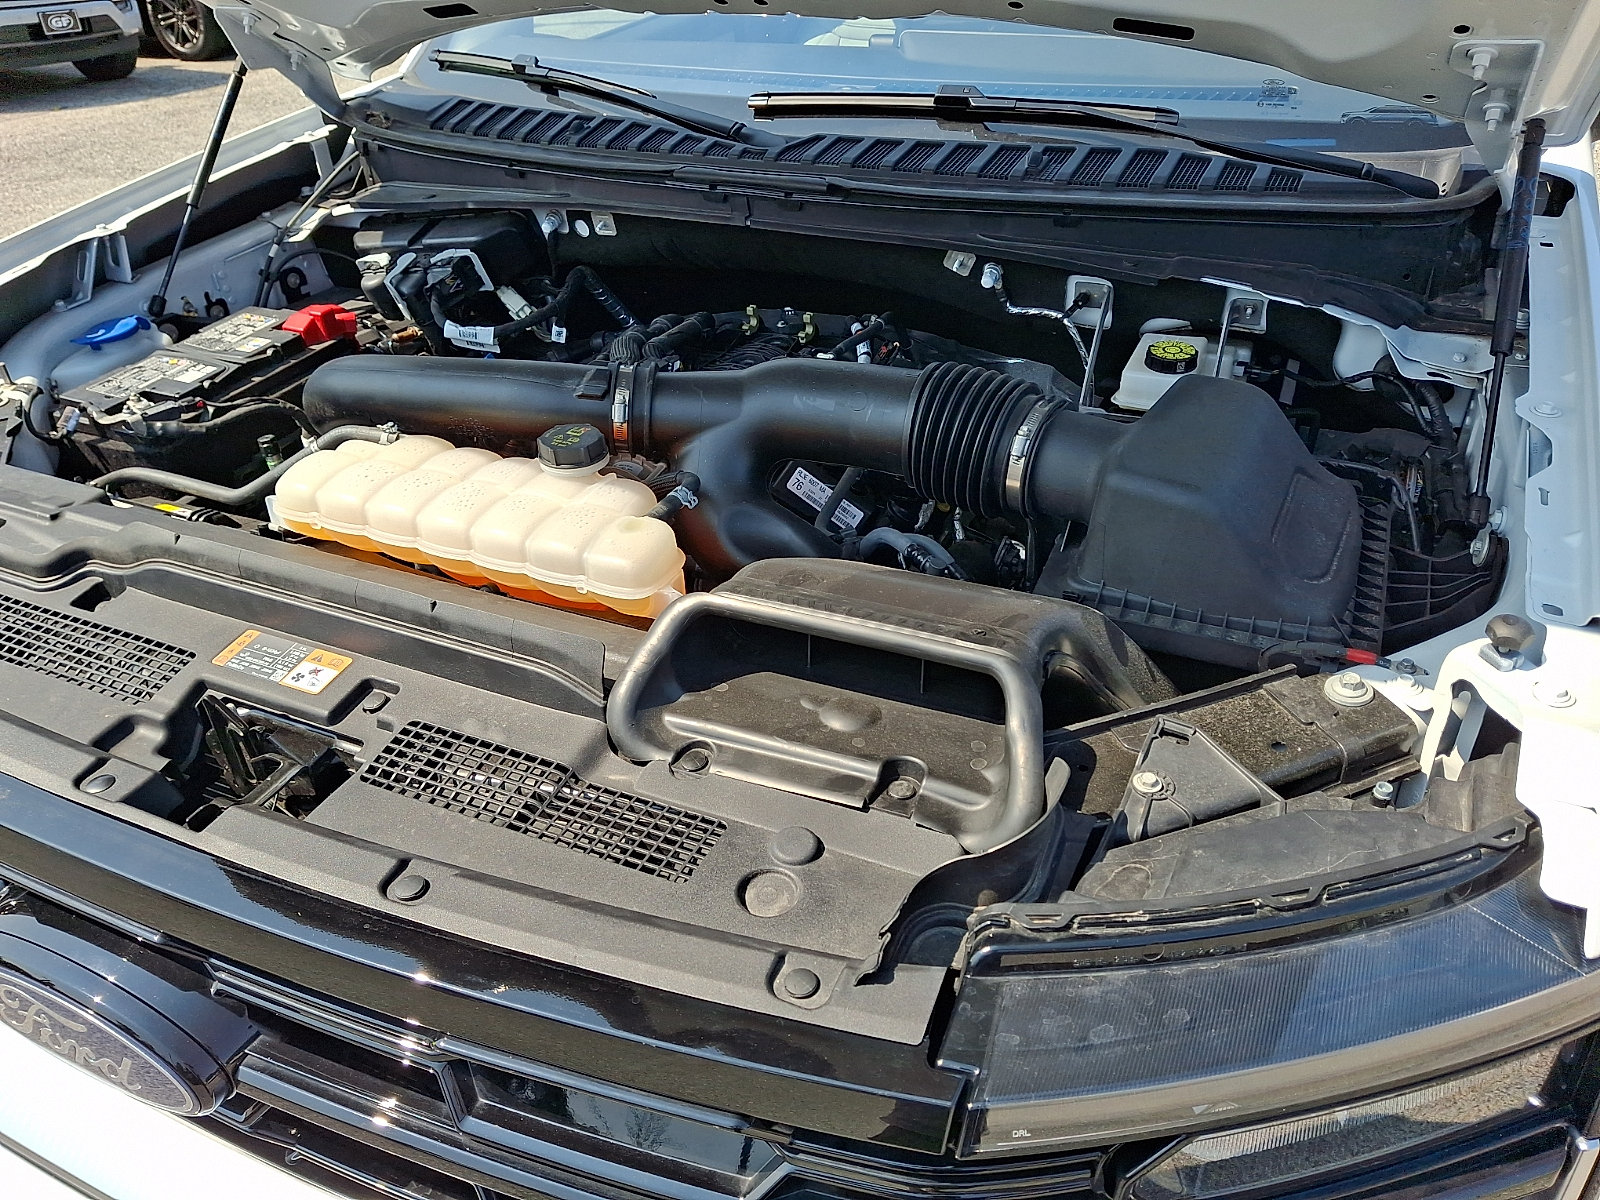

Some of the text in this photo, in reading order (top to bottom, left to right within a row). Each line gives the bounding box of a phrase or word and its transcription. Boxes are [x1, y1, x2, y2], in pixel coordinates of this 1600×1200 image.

[791, 477, 804, 491] 76
[0, 983, 142, 1091] Ford
[1012, 1129, 1031, 1138] DRL
